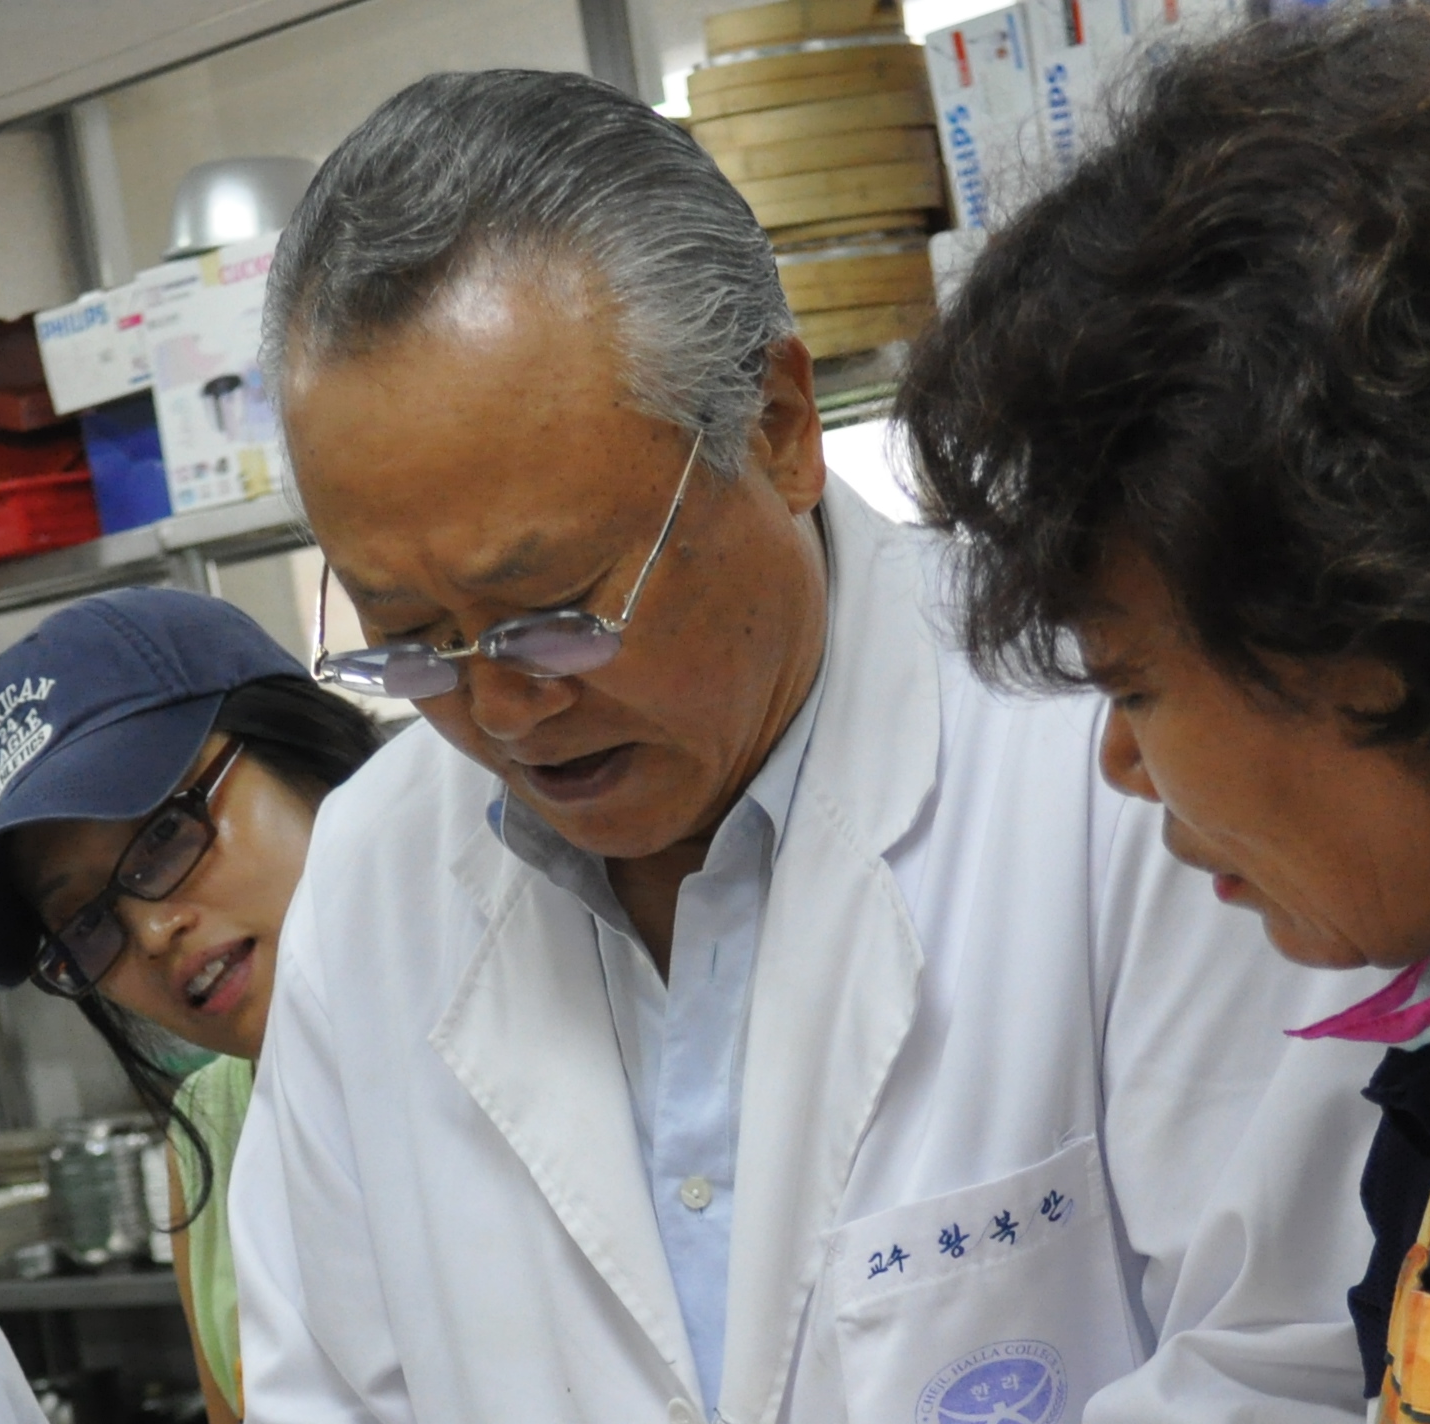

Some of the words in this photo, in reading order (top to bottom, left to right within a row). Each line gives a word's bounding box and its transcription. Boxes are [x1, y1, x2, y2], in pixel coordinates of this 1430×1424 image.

[867, 1244, 910, 1279] 교수
[921, 1376, 951, 1414] CHEJU
[952, 1348, 1001, 1376] HALLA
